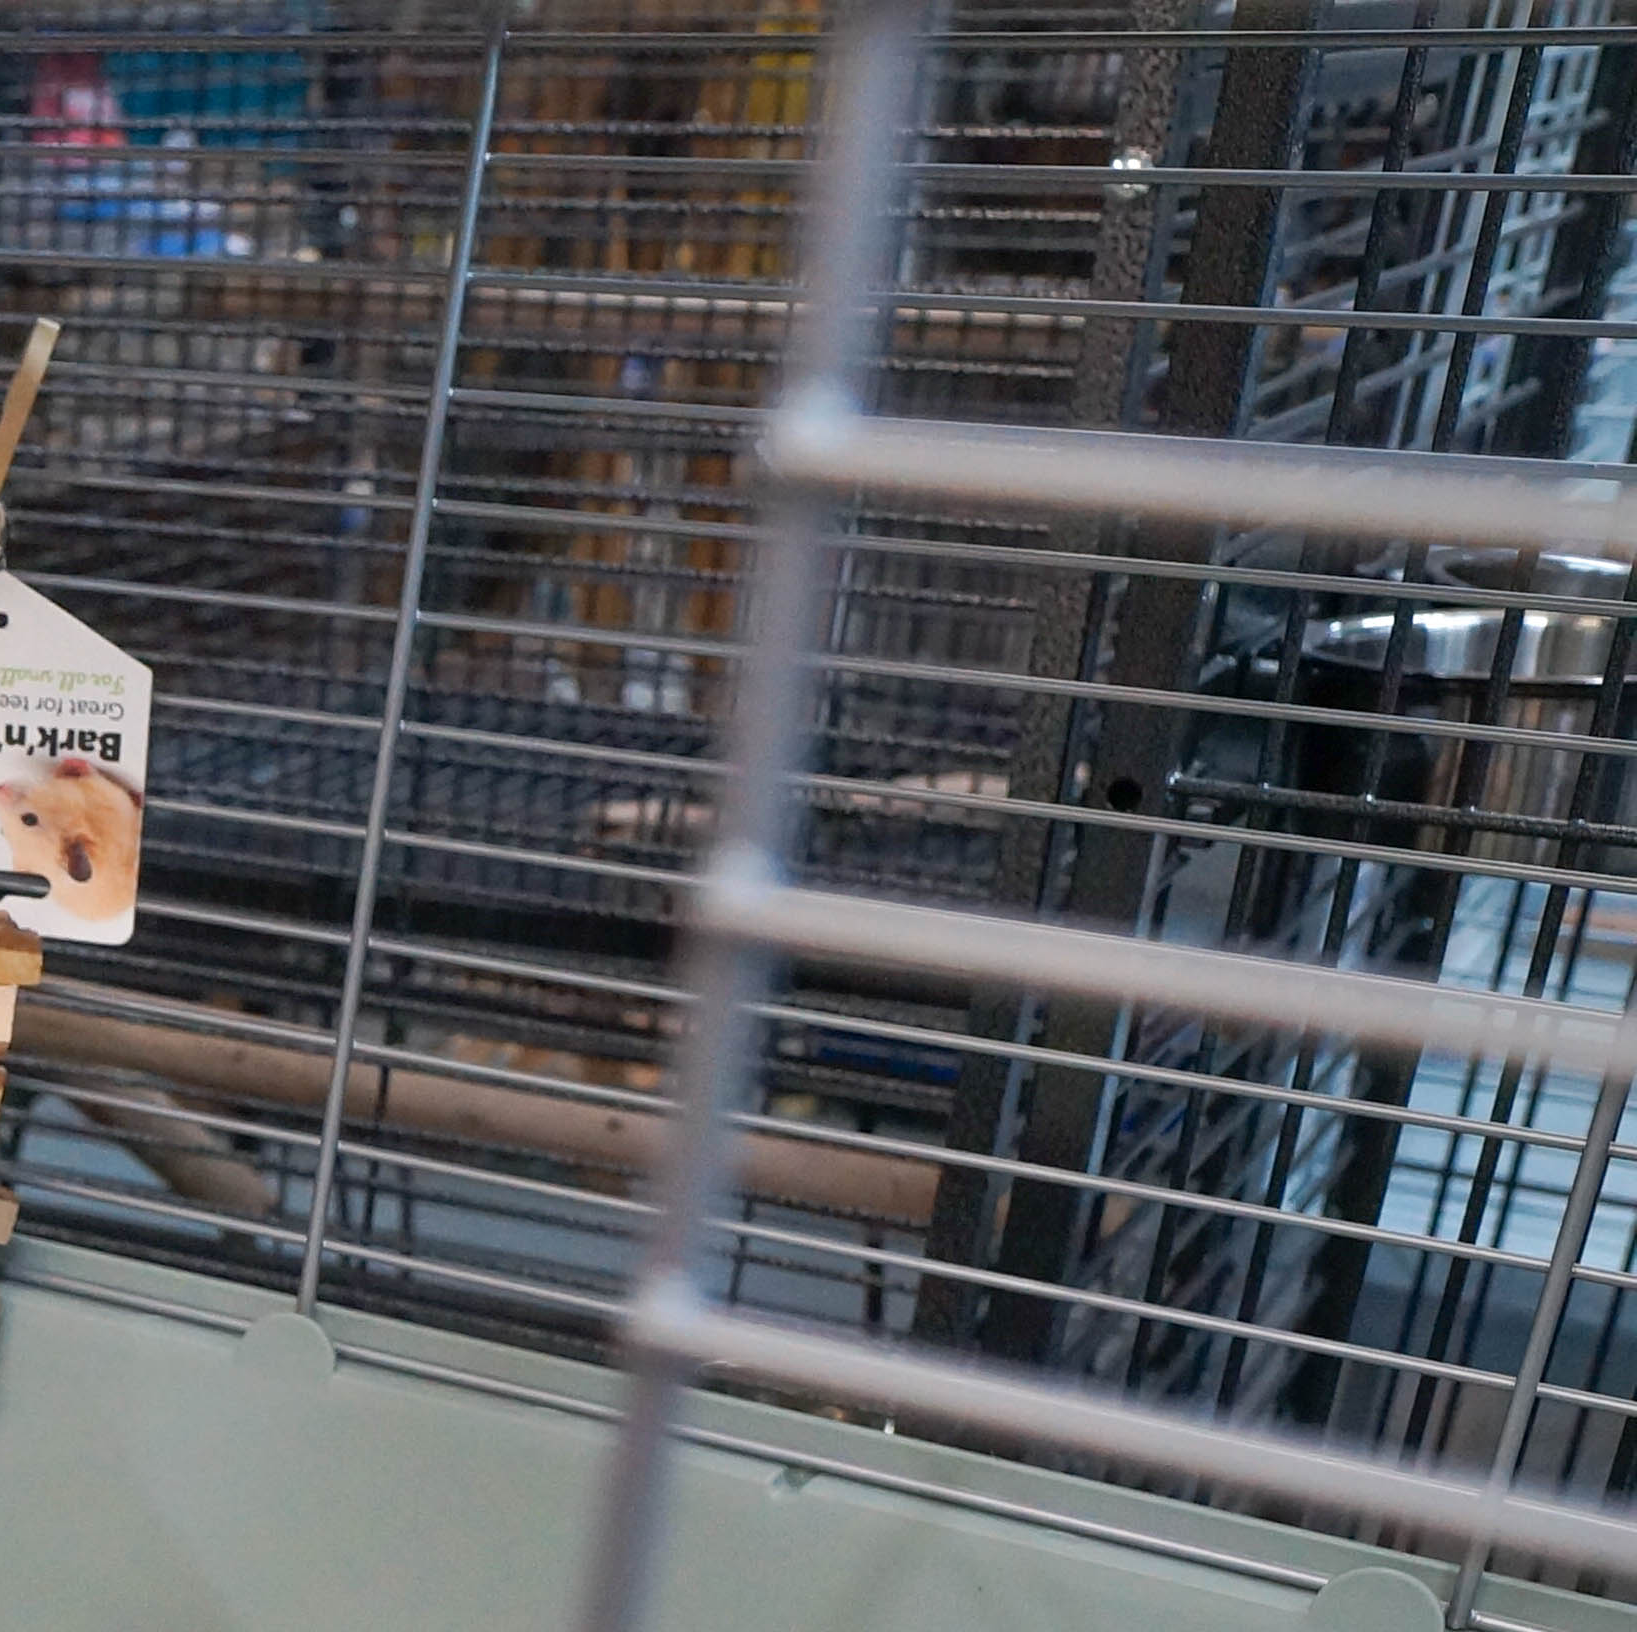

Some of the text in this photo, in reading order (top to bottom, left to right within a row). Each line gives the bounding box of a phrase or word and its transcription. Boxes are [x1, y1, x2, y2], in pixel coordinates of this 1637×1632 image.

[0, 666, 56, 688] small
[59, 671, 87, 693] all
[87, 672, 125, 695] For
[34, 697, 63, 715] for
[69, 696, 125, 720] Great
